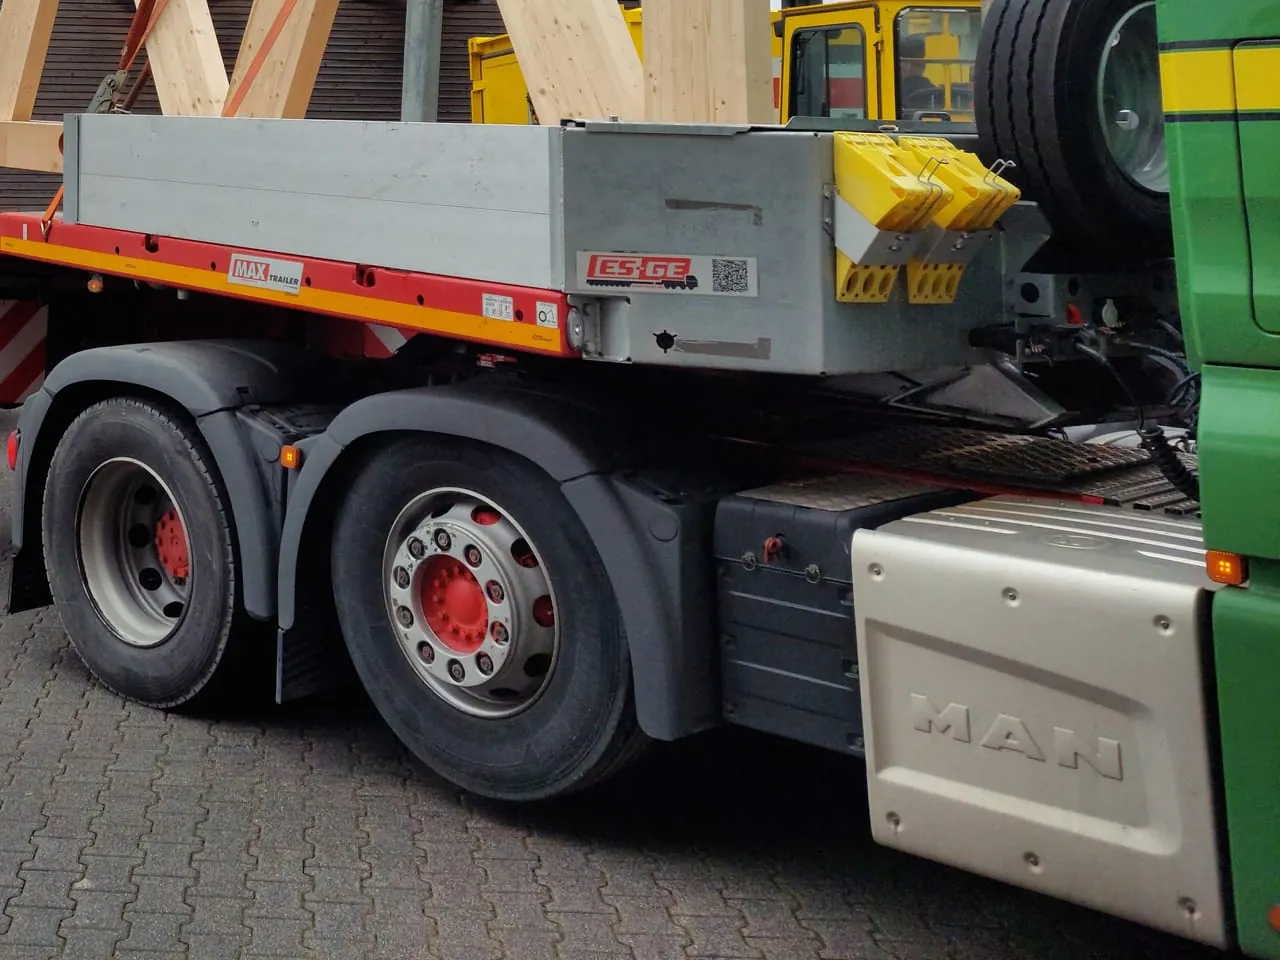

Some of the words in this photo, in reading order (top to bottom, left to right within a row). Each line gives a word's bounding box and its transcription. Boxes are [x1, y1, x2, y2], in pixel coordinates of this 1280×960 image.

[234, 260, 266, 280] MAX
[269, 274, 299, 285] TRAILER
[910, 692, 1124, 782] MAN
